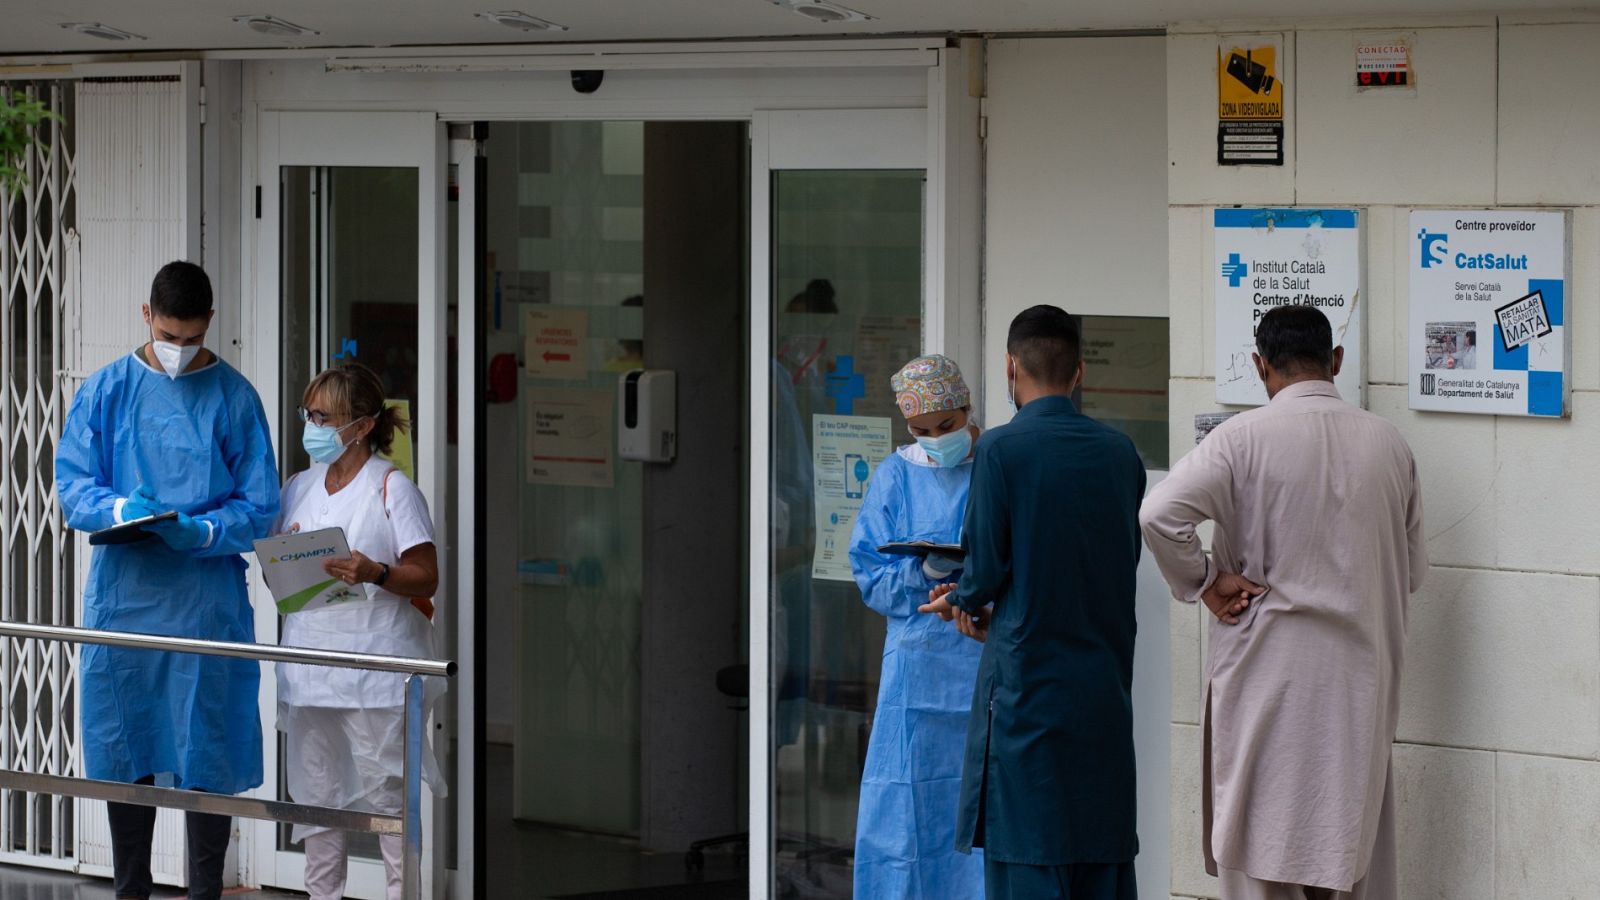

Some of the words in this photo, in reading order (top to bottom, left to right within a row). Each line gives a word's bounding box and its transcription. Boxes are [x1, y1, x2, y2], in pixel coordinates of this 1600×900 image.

[1222, 102, 1237, 116] ZONA
[1238, 102, 1280, 116] VIDEOVIGILADA
[1455, 219, 1487, 231] Centre
[1489, 220, 1536, 233] proveïdor
[1252, 260, 1288, 274] Institut
[1290, 260, 1326, 275] Català
[1455, 252, 1528, 270] CatSalut
[1252, 276, 1267, 290] de
[1269, 277, 1280, 290] la
[1282, 276, 1310, 290] Salut
[1455, 282, 1477, 291] Servei
[1478, 282, 1501, 292] Català
[1253, 292, 1291, 306] Centre
[1292, 293, 1345, 307] d'Atenció
[1455, 293, 1464, 301] de
[1465, 293, 1473, 301] la
[1474, 293, 1492, 302] Salut
[1500, 297, 1539, 321] RETALLAR
[1503, 319, 1514, 329] LA
[1512, 303, 1541, 325] SANITAT
[1506, 314, 1546, 343] MATA
[1438, 378, 1474, 388] Generalitat
[1475, 380, 1484, 389] de
[1485, 380, 1520, 391] Catalunya
[1438, 388, 1482, 399] Departament
[1484, 390, 1494, 399] de
[1495, 391, 1515, 400] Salut
[836, 422, 849, 430] CAP
[280, 547, 336, 561] CHAMPIX
